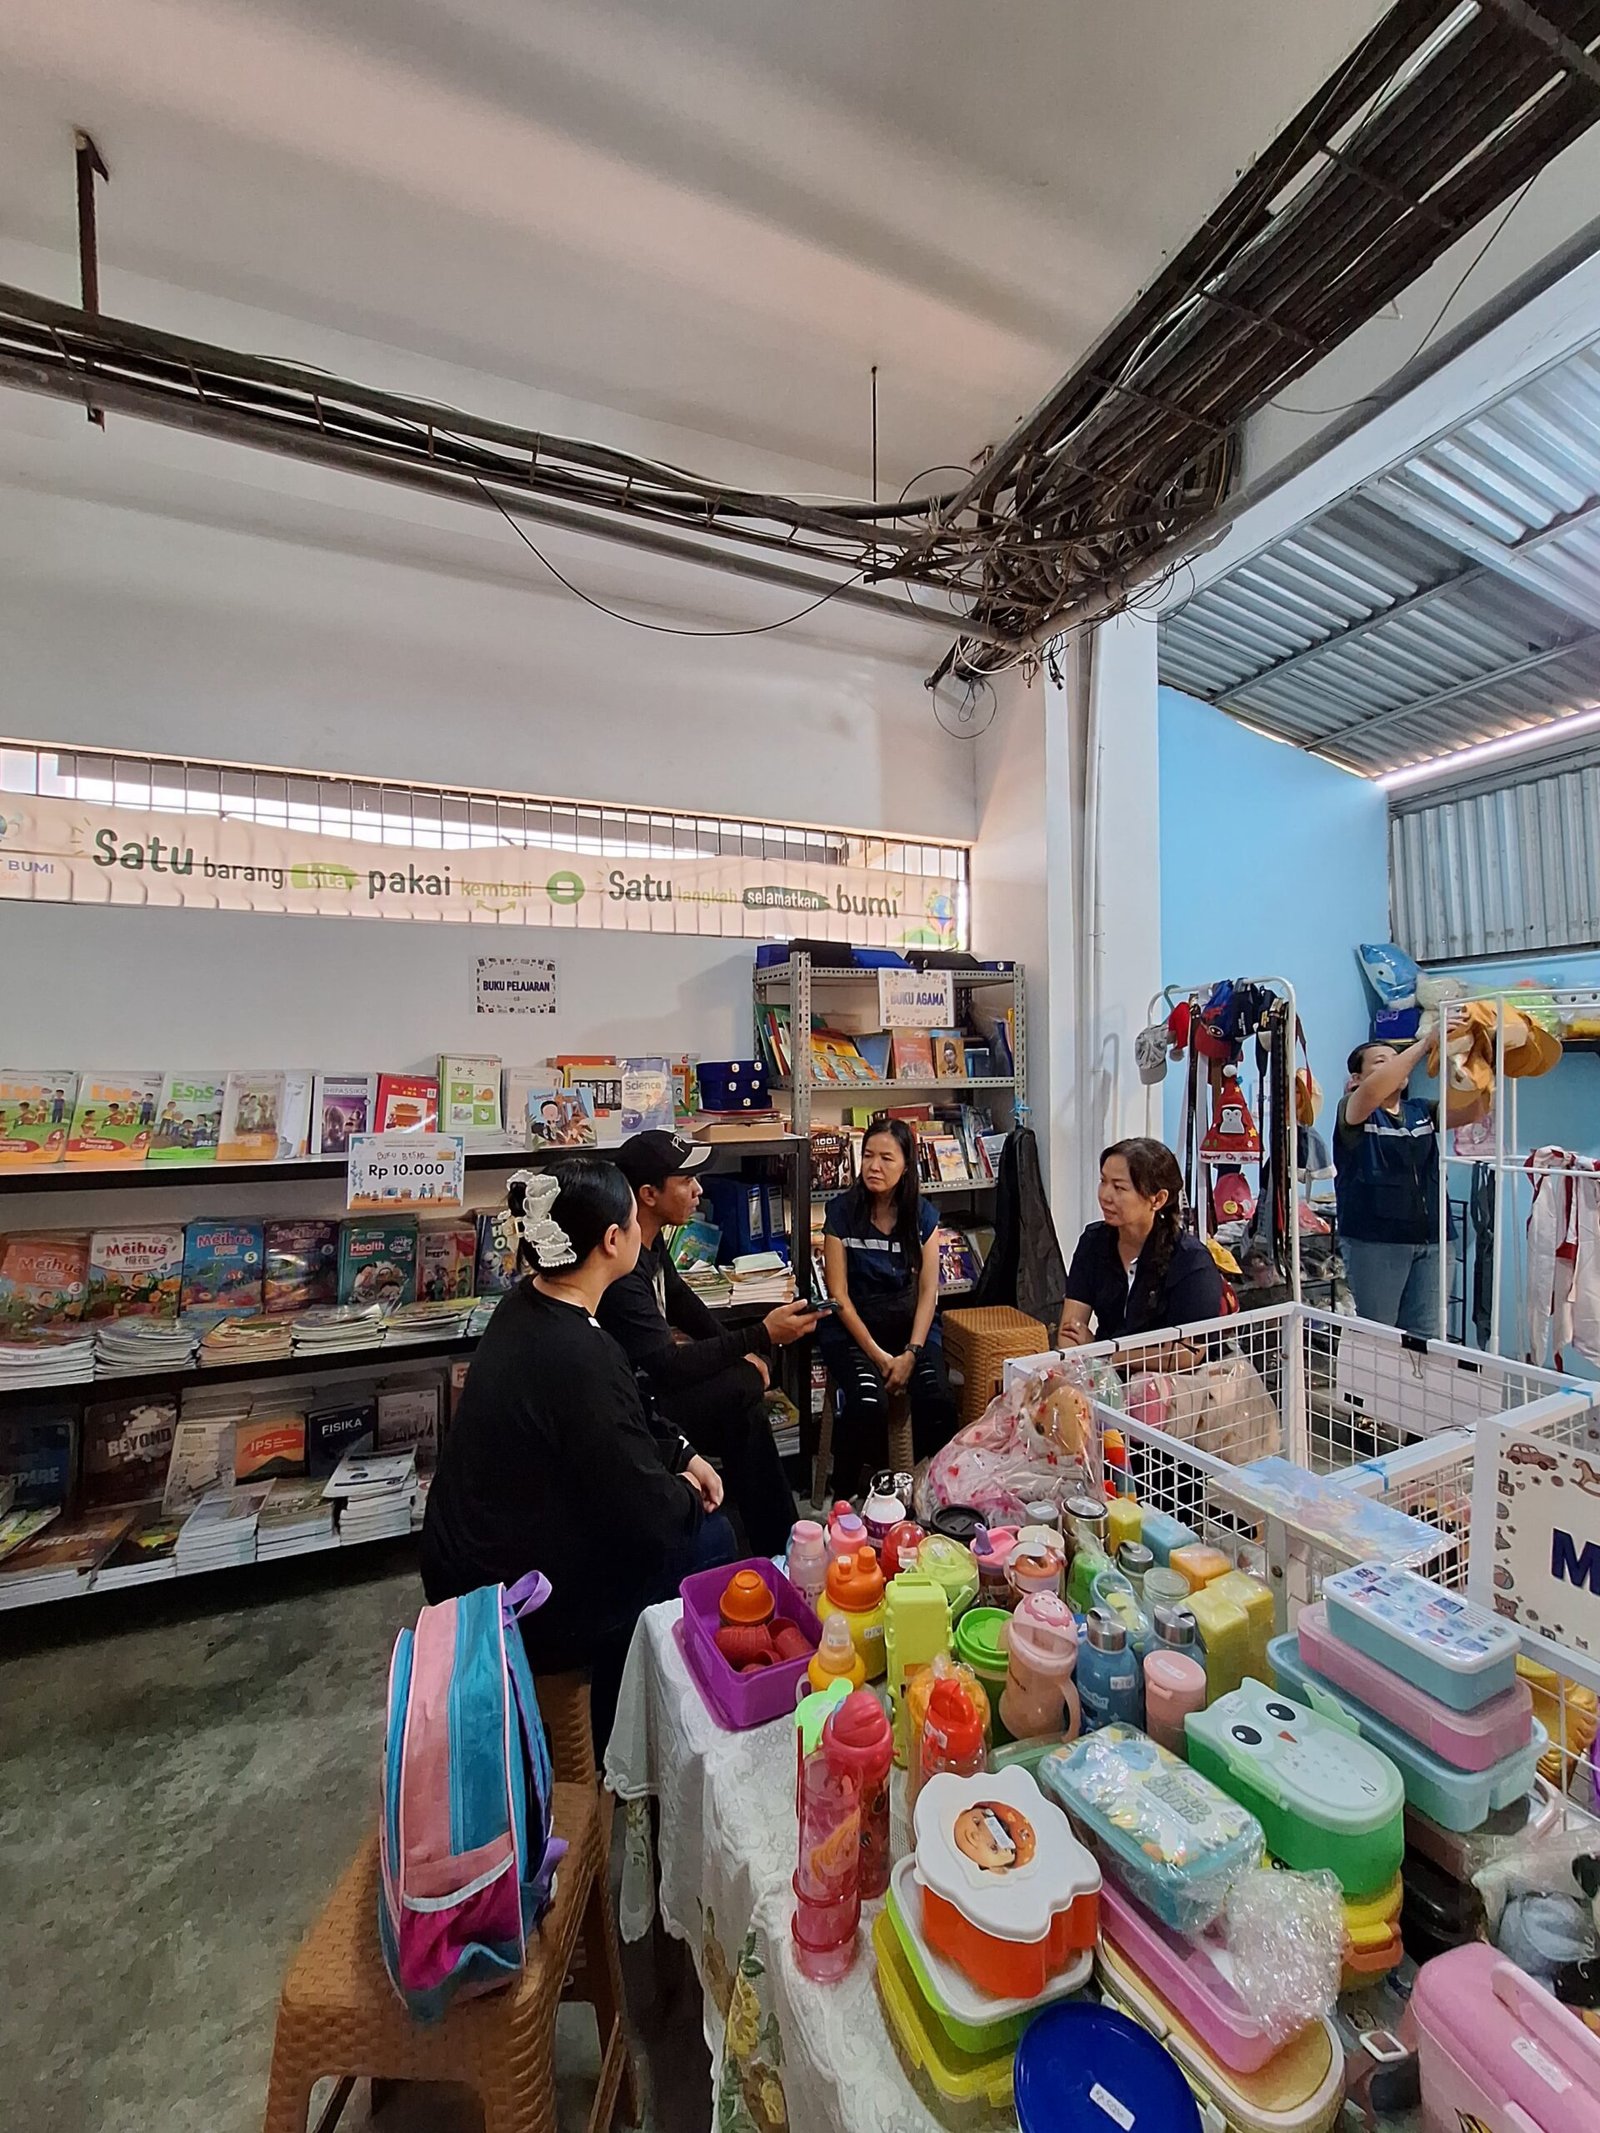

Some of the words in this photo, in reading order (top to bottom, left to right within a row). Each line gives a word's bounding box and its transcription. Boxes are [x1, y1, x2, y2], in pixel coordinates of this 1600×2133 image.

[8, 860, 54, 874] BUMI
[93, 828, 194, 876] Satu
[203, 856, 285, 890] barang
[306, 864, 347, 889] kita
[368, 863, 451, 900] pakai
[461, 877, 533, 899] kembali
[608, 869, 673, 903] Satu
[677, 885, 738, 909] langkah
[746, 889, 820, 910] selamatkan
[836, 884, 899, 919] bumi
[482, 980, 505, 991] BUKU
[507, 981, 550, 992] PELAJARAN
[890, 993, 914, 1005] BUKU
[916, 992, 945, 1006] AGAMA
[455, 1066, 476, 1077] 中文
[625, 1081, 662, 1091] Science
[53, 1131, 61, 1140] 4
[138, 1132, 147, 1140] 4
[816, 1136, 837, 1146] 1001
[377, 1151, 398, 1161] BUKU
[369, 1164, 389, 1180] Rp
[393, 1163, 445, 1176] 10.000
[351, 1241, 386, 1252] Health
[247, 1252, 255, 1262] 5
[71, 1283, 80, 1292] 3
[322, 1418, 363, 1436] FISIKA
[107, 1427, 172, 1457] BEYOND
[251, 1439, 273, 1452] IPS
